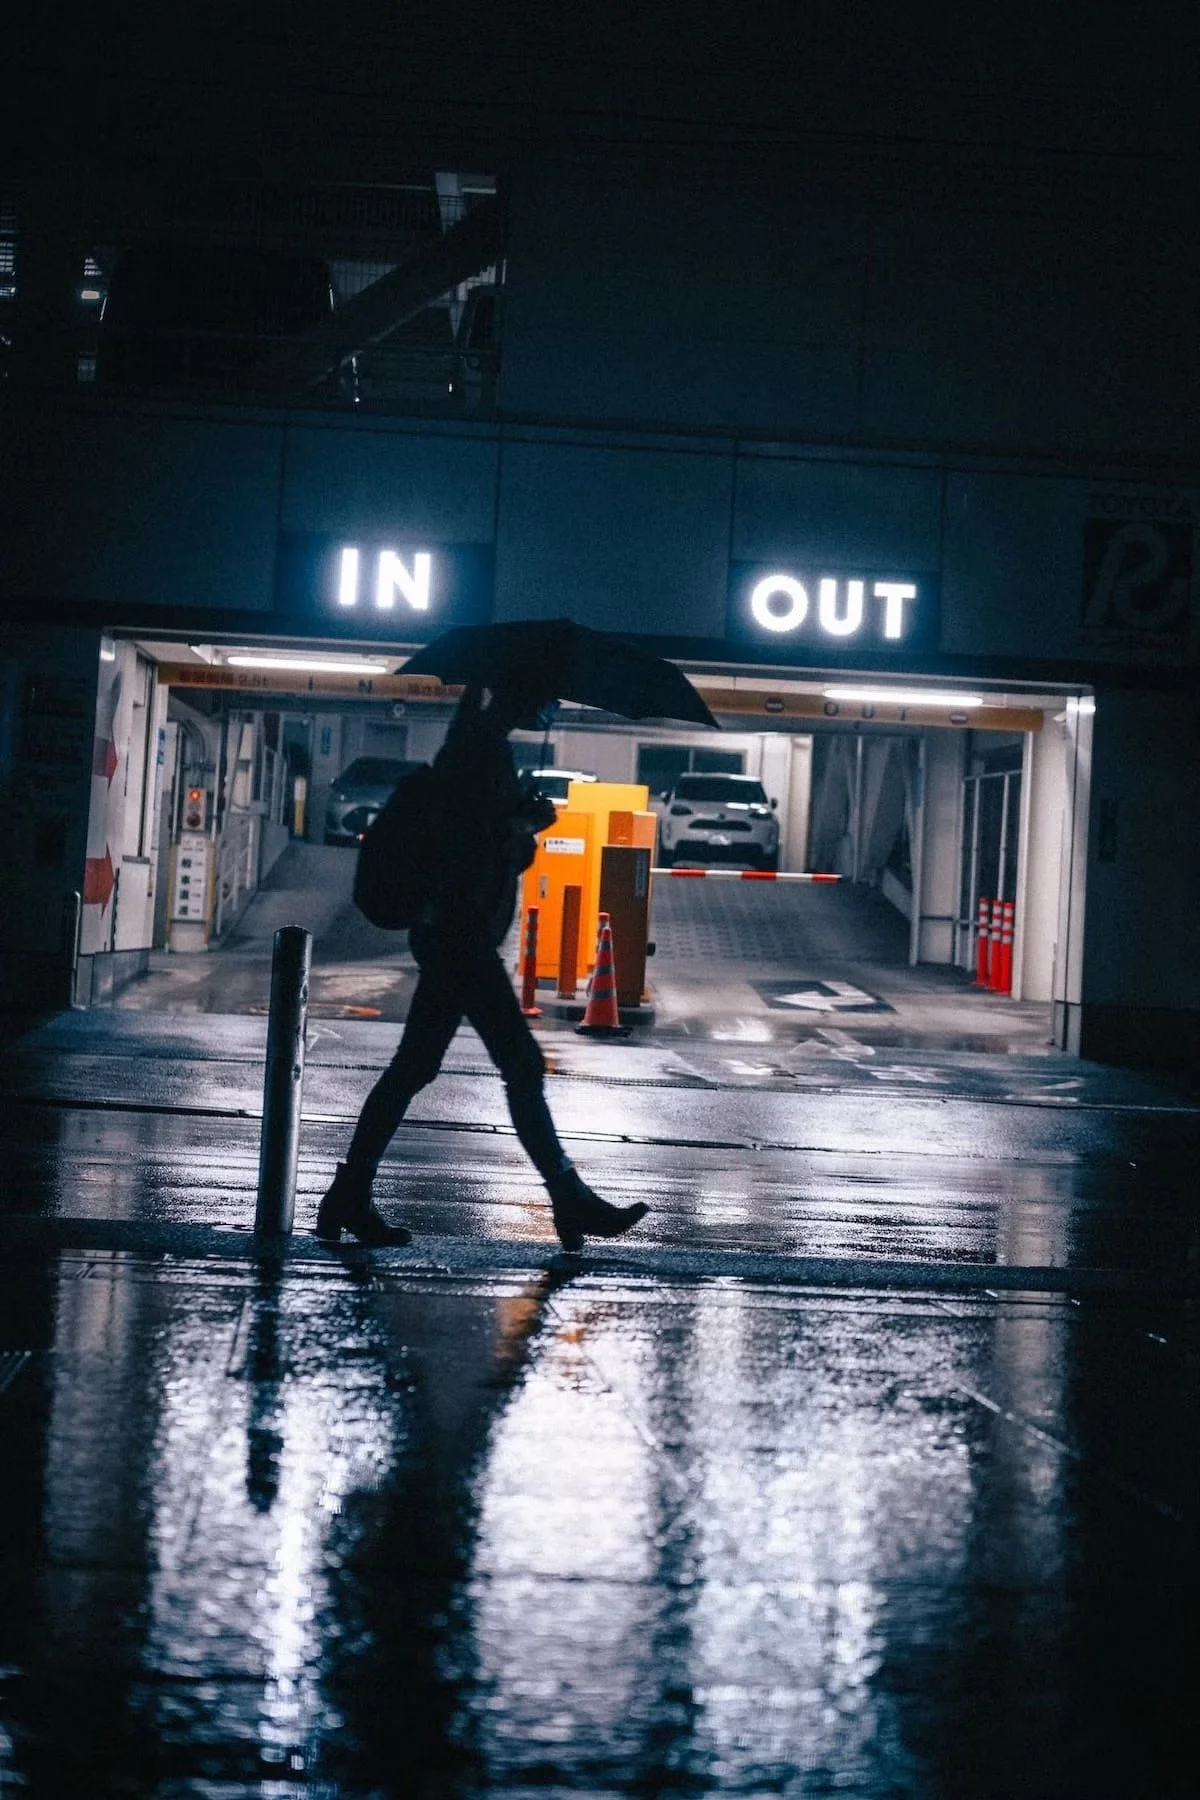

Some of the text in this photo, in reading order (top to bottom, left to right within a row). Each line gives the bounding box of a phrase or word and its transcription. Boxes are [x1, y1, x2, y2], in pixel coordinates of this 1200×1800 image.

[338, 547, 432, 611] IN
[751, 574, 917, 640] OUT
[823, 700, 911, 722] OUT
